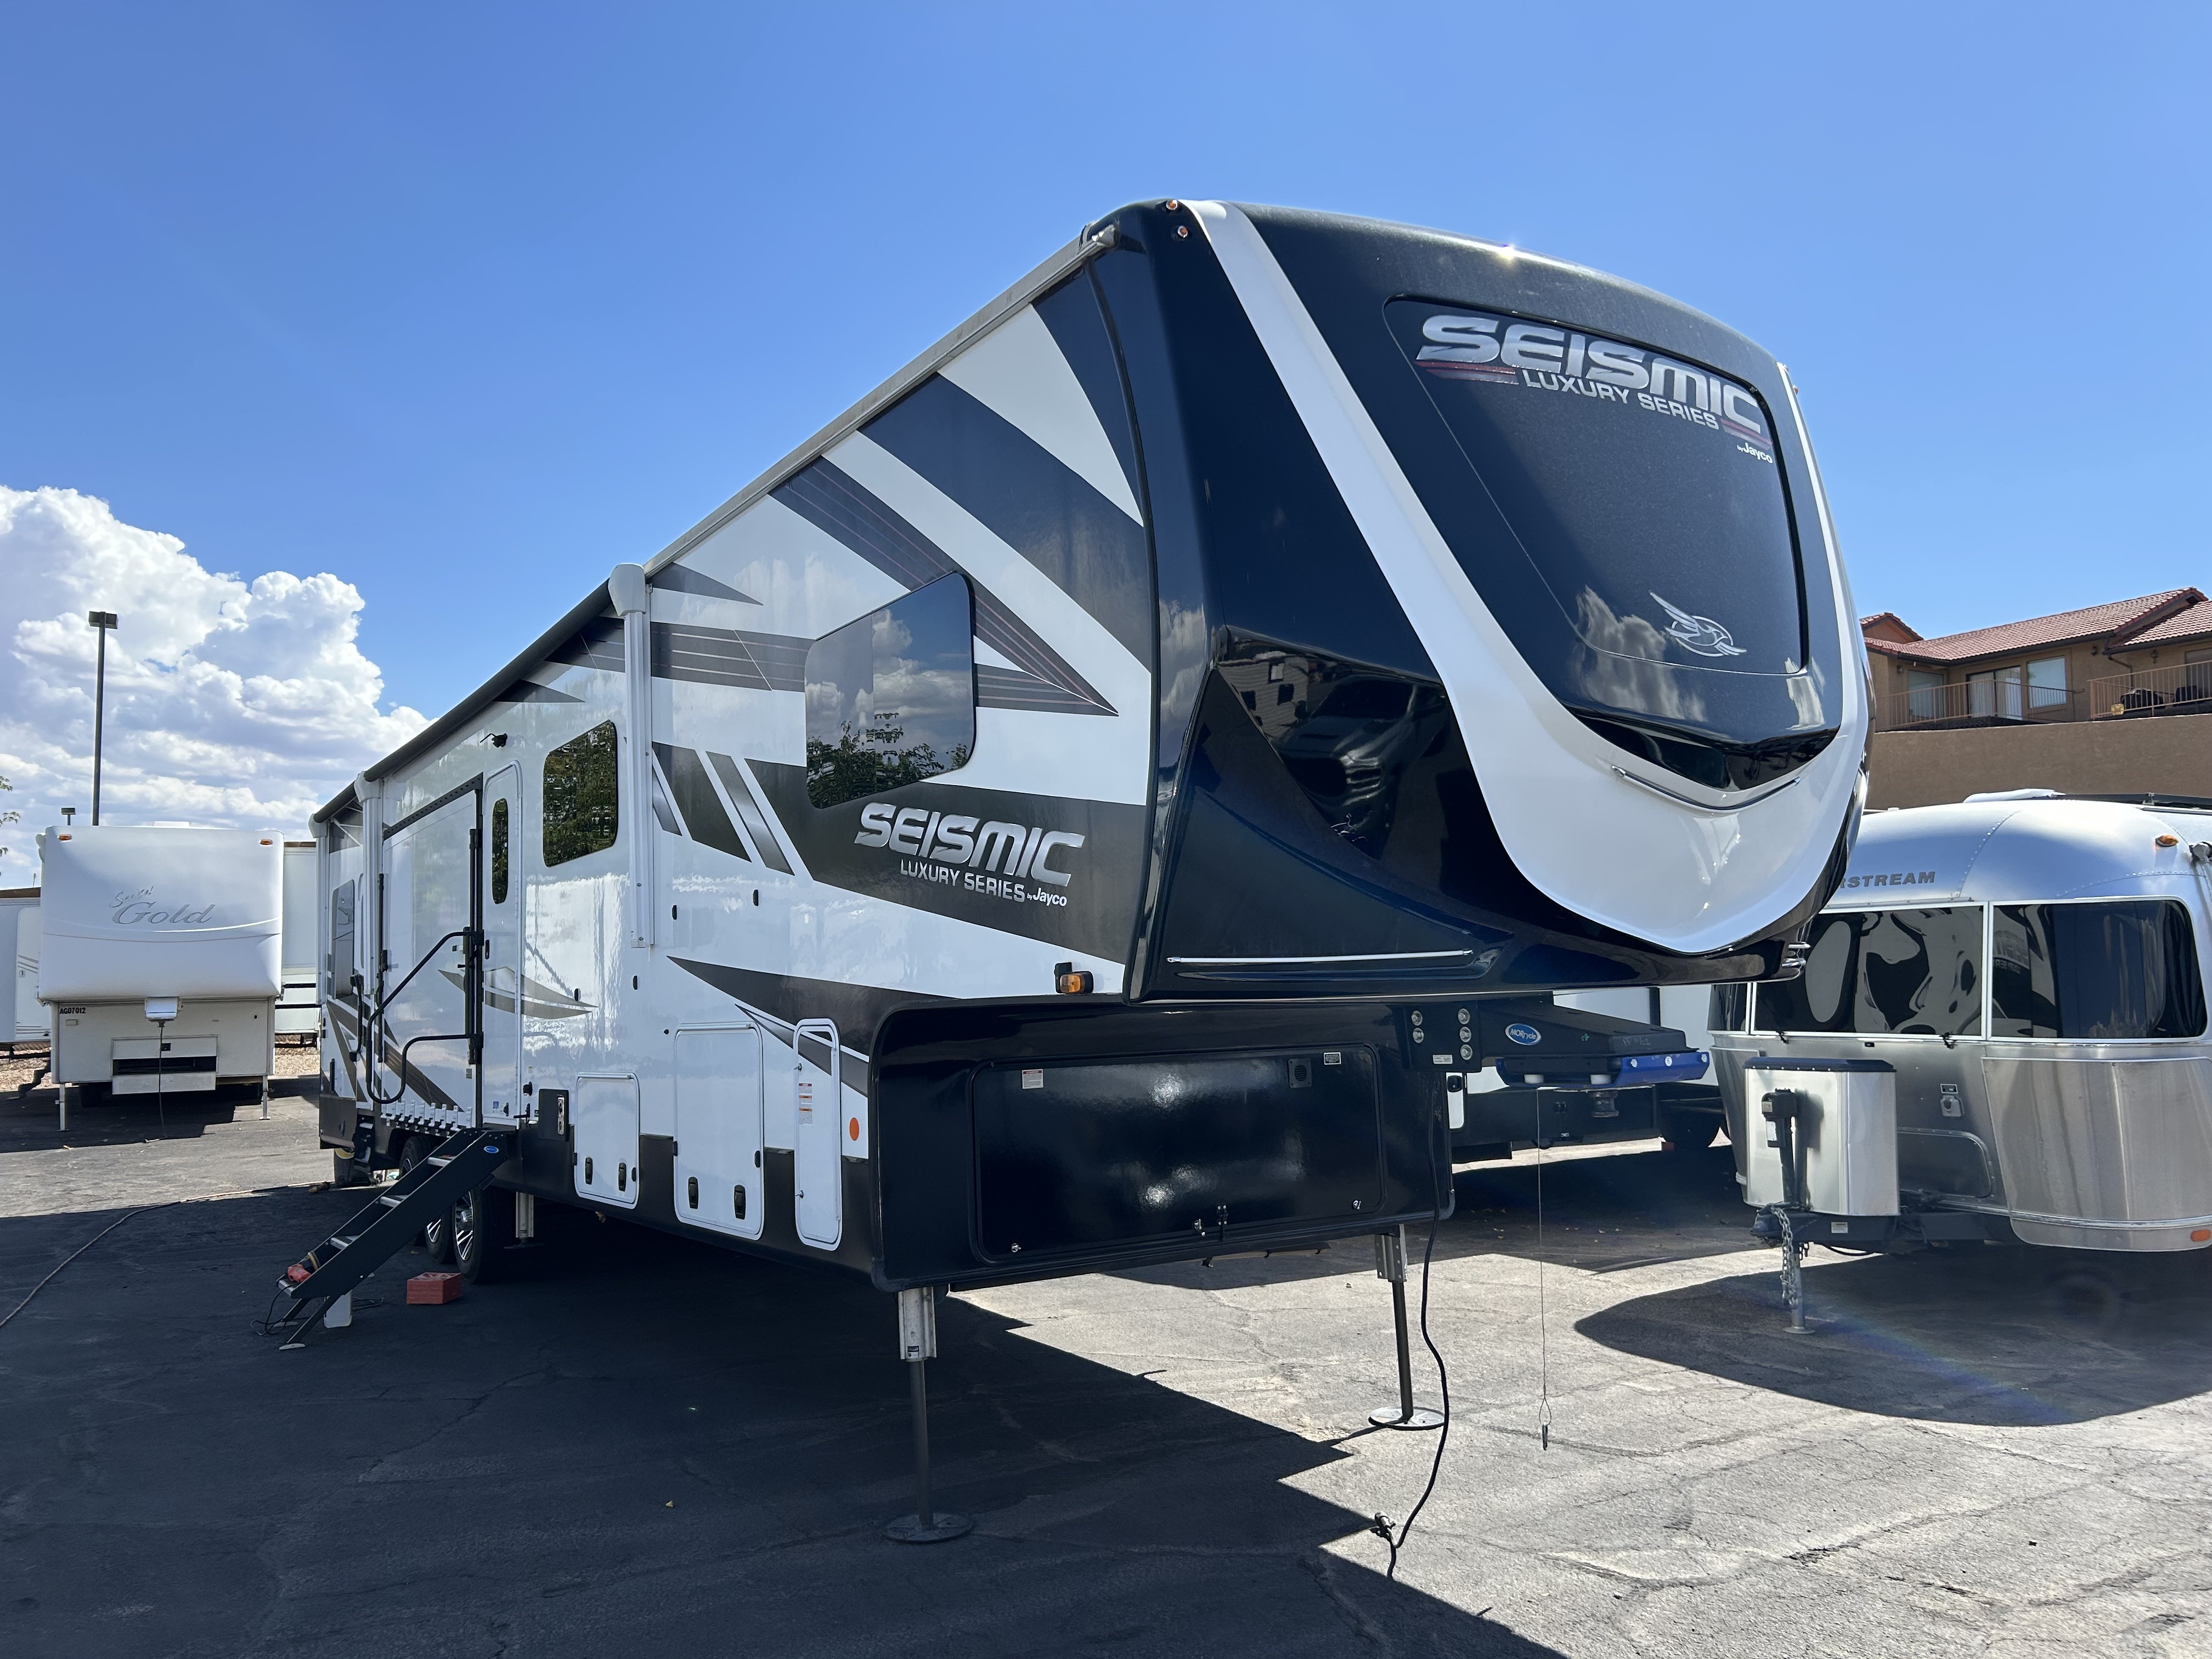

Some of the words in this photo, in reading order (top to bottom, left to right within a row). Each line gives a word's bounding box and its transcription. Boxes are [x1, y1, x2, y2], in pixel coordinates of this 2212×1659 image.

[1416, 314, 1760, 433] SEISMIC
[1522, 370, 1629, 404] LUXURY
[1637, 392, 1719, 430] SERIES
[1743, 442, 1773, 464] Jayco
[854, 802, 1085, 887] SEISMIC
[900, 859, 960, 887] LUXURY
[964, 872, 1025, 903] SERIES
[1026, 893, 1033, 901] by
[1032, 887, 1068, 907] Jayco
[111, 901, 216, 924] Gold
